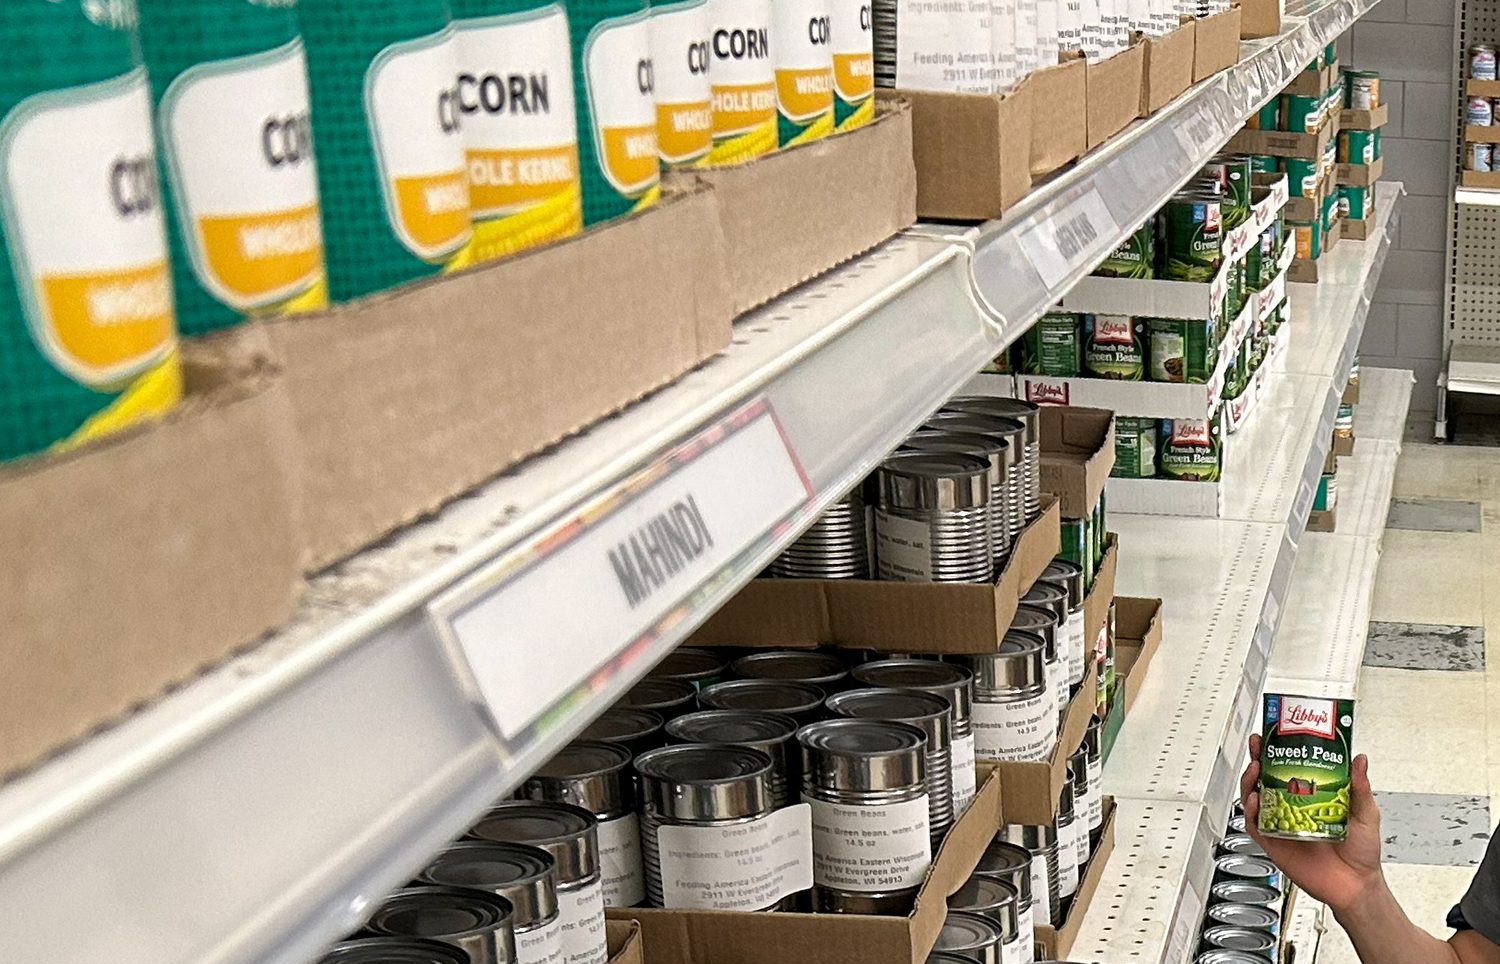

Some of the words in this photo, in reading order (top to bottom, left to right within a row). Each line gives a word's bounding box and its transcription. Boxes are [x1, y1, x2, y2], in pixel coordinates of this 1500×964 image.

[712, 27, 769, 60] CORN
[913, 50, 954, 66] Feeding
[458, 73, 550, 114] CORN
[467, 156, 517, 186] OLE
[1086, 352, 1113, 362] Green
[1115, 352, 1142, 363] Beans
[1162, 454, 1190, 464] Green
[1193, 454, 1218, 464] Beans
[606, 493, 715, 610] MAHINDI
[1283, 705, 1328, 727] Libby's
[1267, 744, 1308, 758] Sweet
[1312, 746, 1343, 764] Peas
[833, 808, 858, 817] Green
[860, 809, 887, 818] Beans
[826, 855, 858, 865] America
[845, 866, 889, 877] Evergreen
[890, 864, 910, 874] Drive
[863, 877, 876, 886] WI
